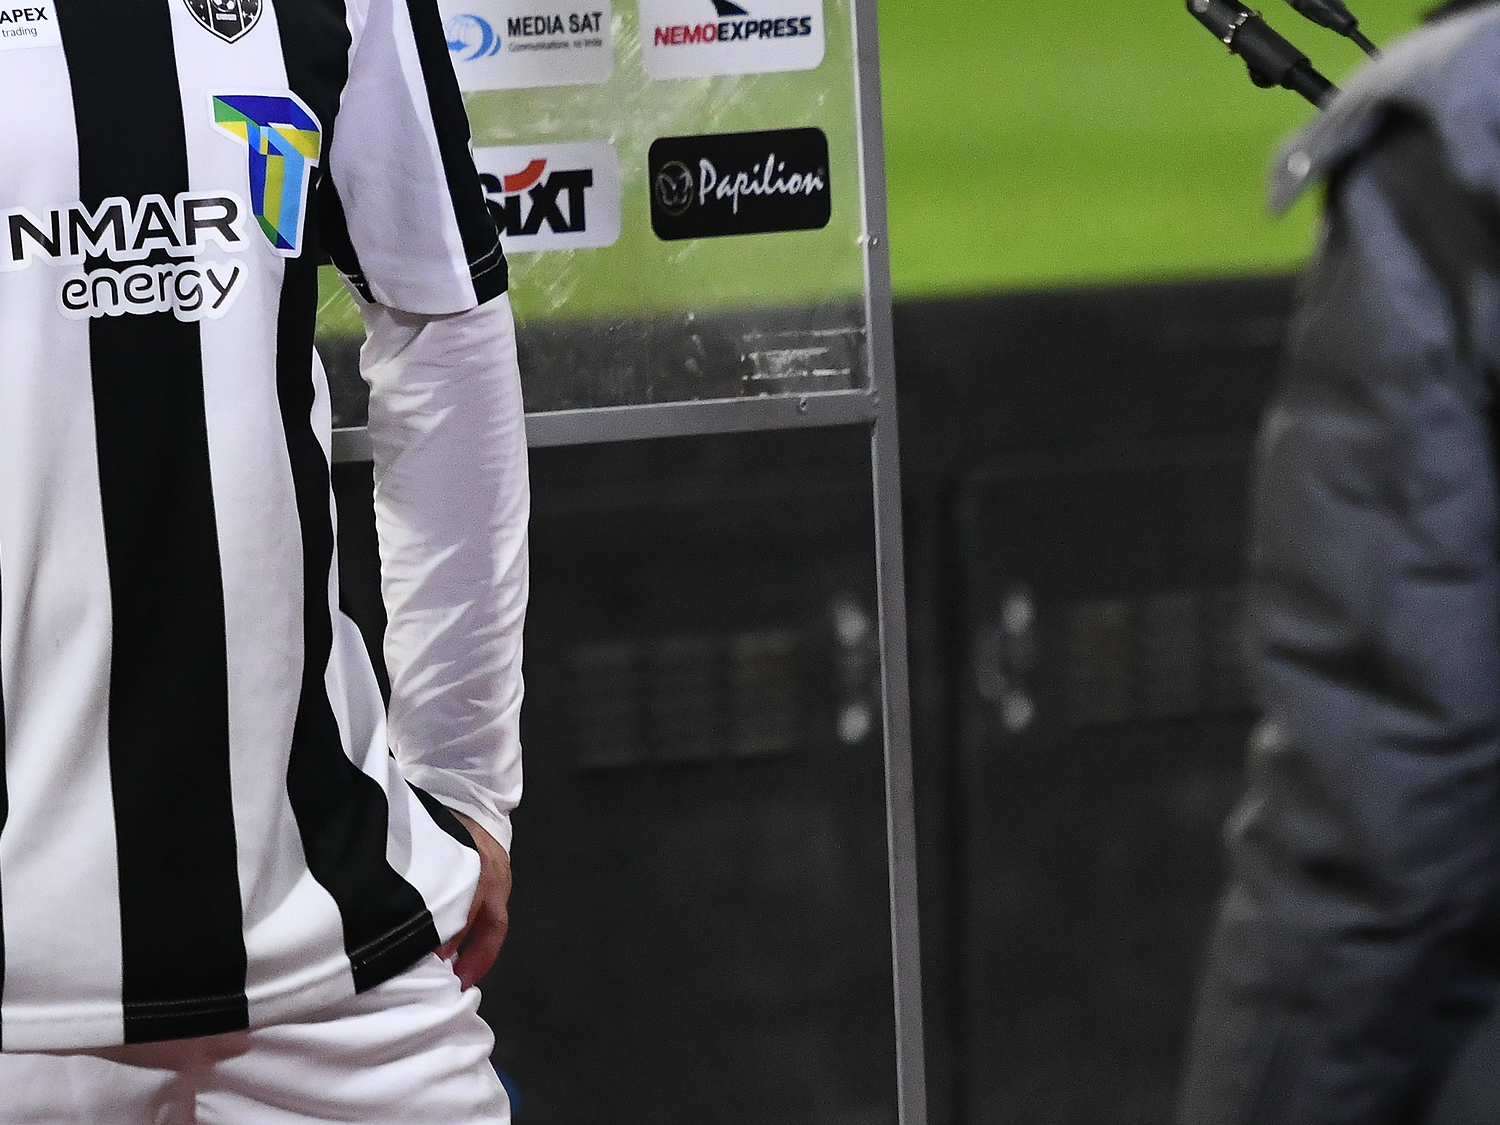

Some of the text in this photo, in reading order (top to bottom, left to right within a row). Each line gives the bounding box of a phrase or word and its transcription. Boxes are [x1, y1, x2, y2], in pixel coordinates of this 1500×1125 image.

[0, 6, 49, 26] APEX
[507, 10, 604, 37] MEDIA SAT
[654, 15, 812, 46] NEMOEXPRESS
[1, 25, 38, 40] trading
[698, 153, 823, 214] Papilion
[62, 264, 241, 315] energy
